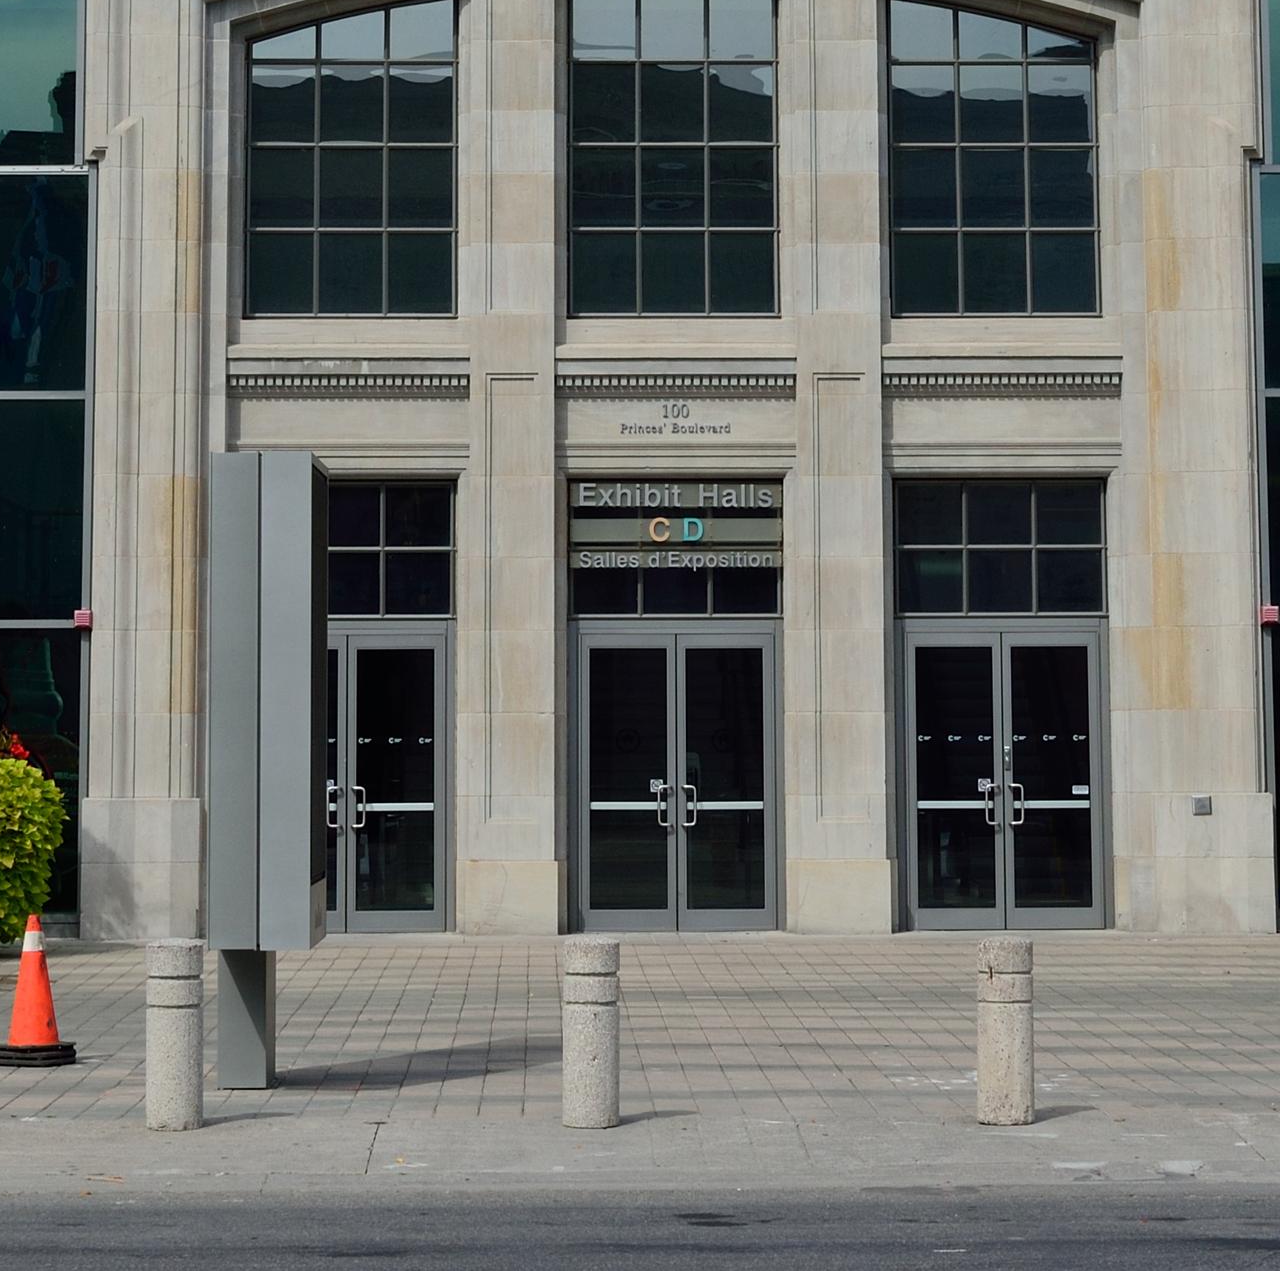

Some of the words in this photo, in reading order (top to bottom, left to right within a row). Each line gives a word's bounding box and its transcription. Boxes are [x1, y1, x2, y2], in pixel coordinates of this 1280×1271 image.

[662, 404, 690, 419] 100
[671, 422, 731, 434] Boulevard
[578, 483, 681, 507] Exhibit
[698, 483, 773, 507] Halls
[649, 517, 670, 542] C
[682, 517, 704, 542] D
[579, 552, 640, 568] Salles
[648, 552, 773, 571] d'Exposition
